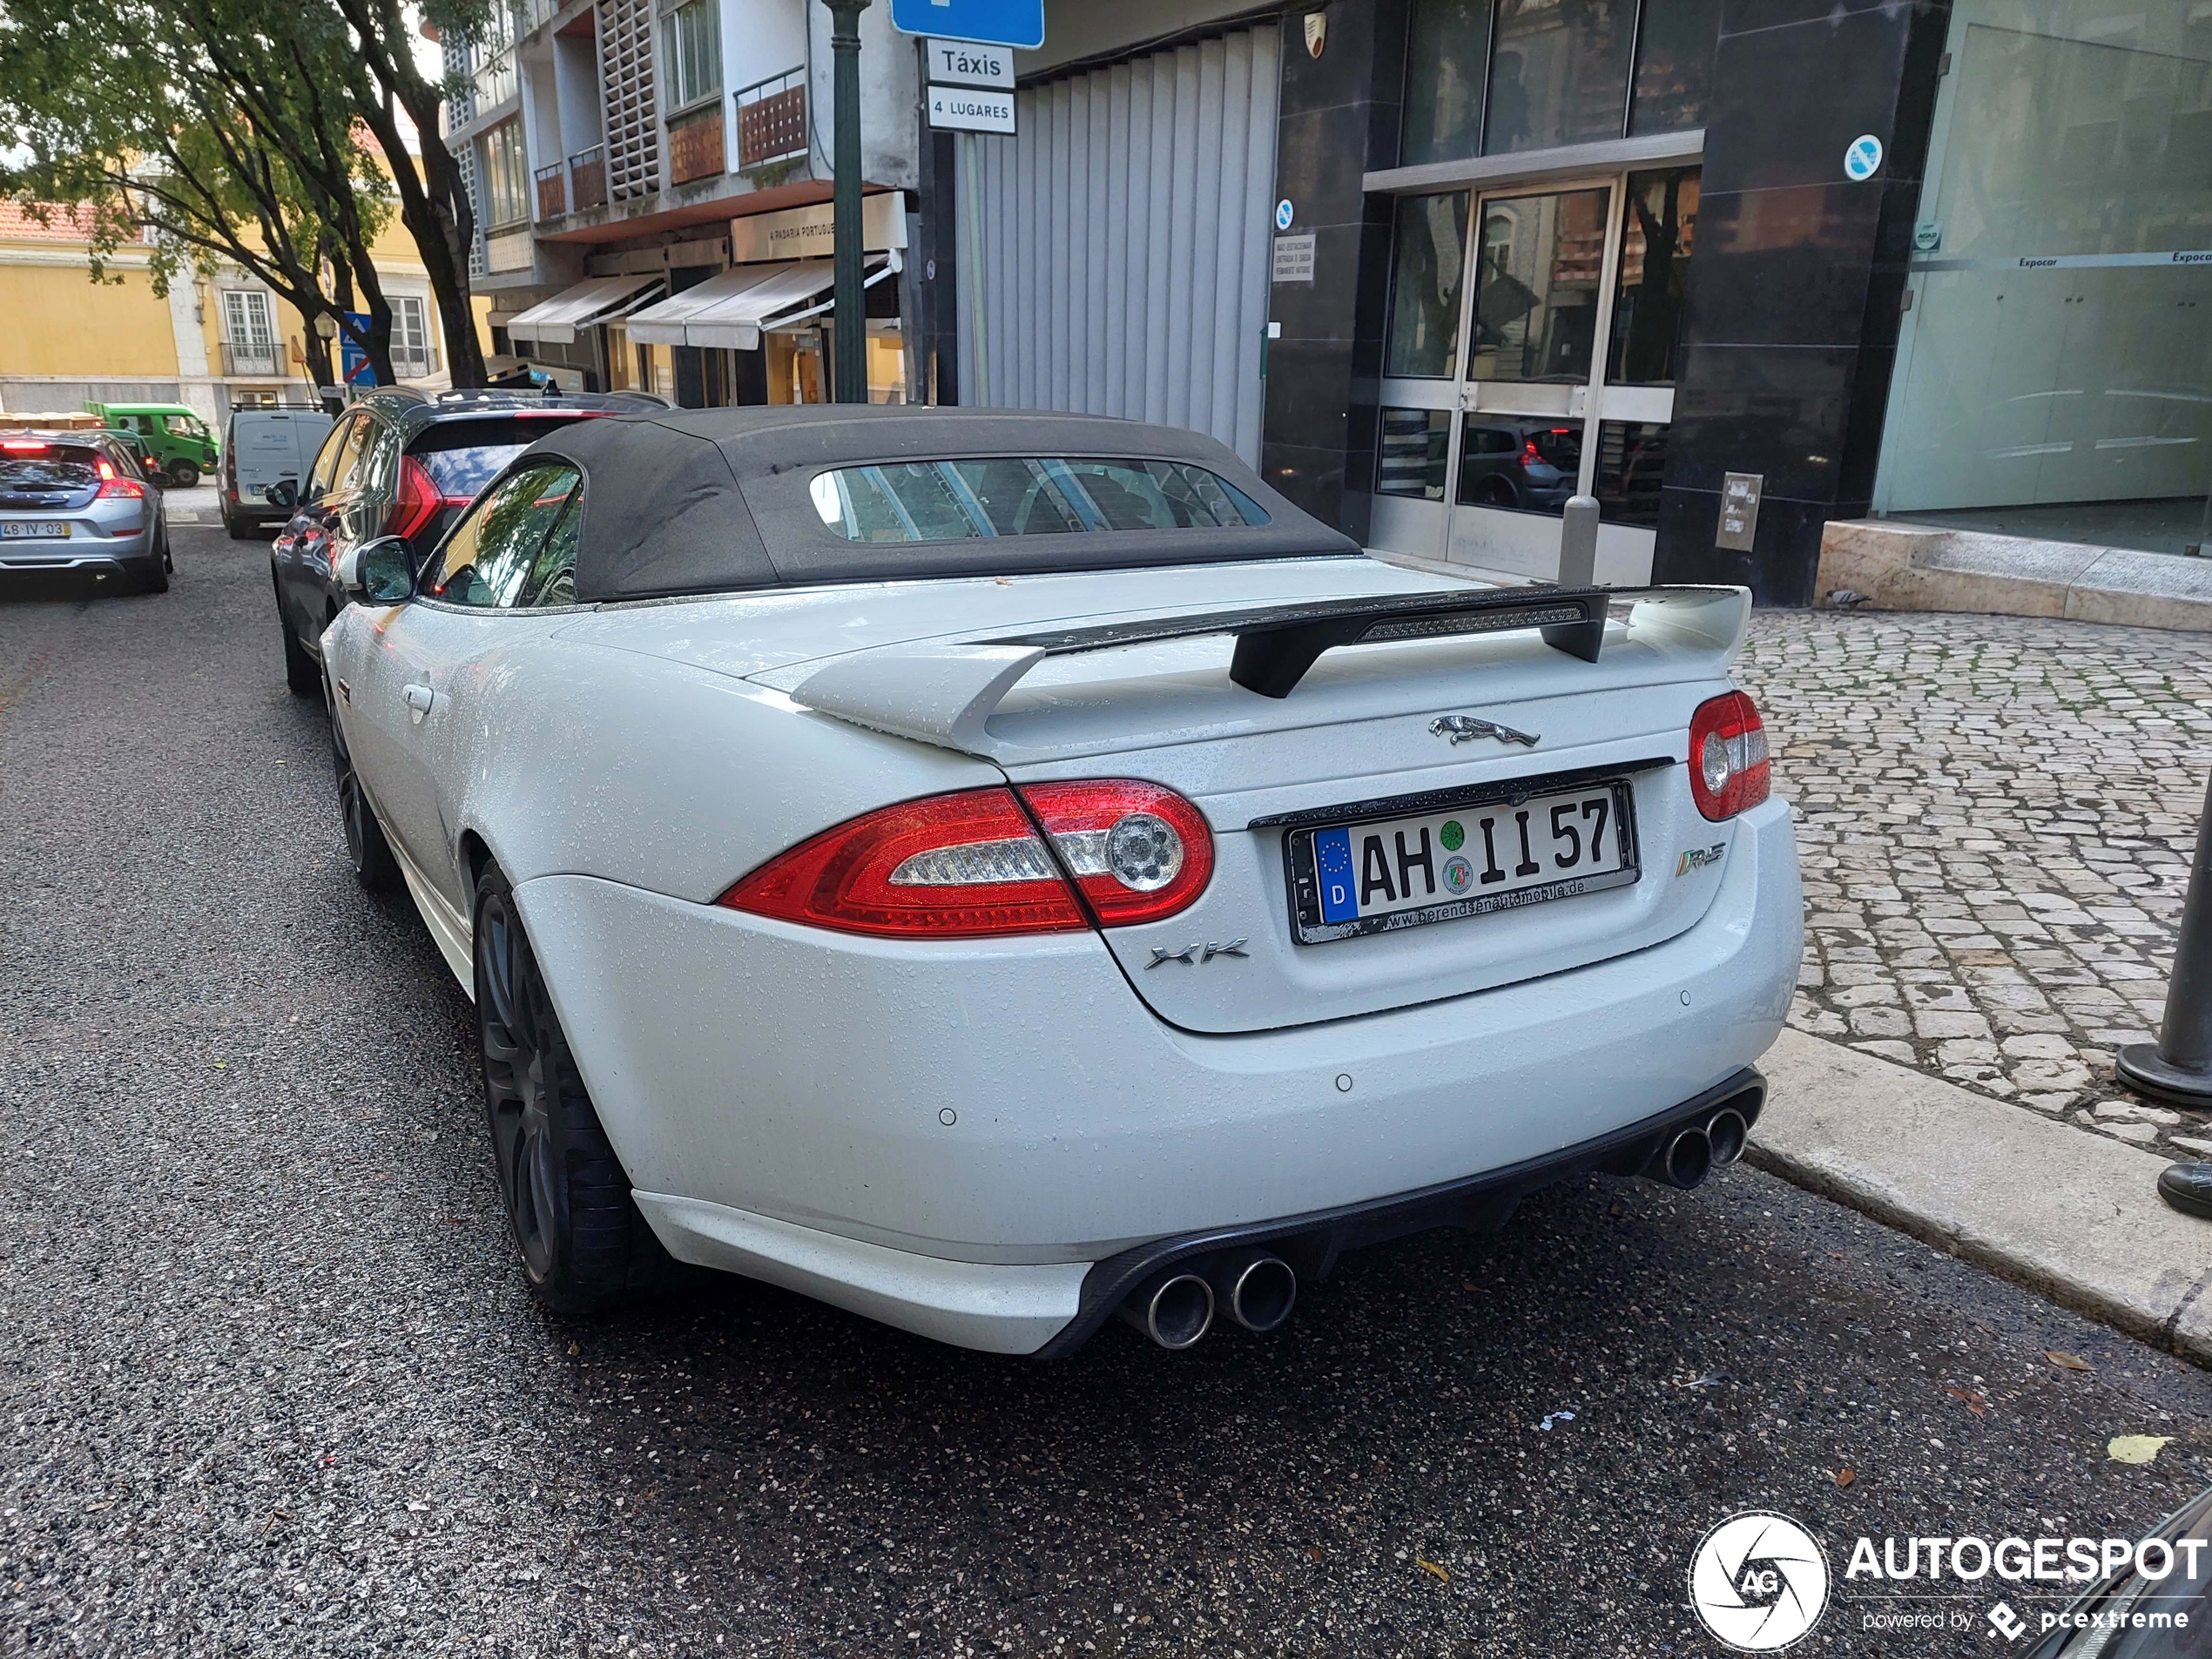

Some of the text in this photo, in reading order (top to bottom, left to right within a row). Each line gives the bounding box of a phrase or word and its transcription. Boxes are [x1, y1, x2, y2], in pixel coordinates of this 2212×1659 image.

[941, 50, 1001, 76] Táxis
[934, 101, 1009, 119] 4 LUGARES
[770, 231, 774, 240] A
[775, 228, 800, 239] PADARIA
[2020, 258, 2057, 269] Expocar
[1360, 826, 1435, 907] AH
[1550, 798, 1609, 869] 57
[1332, 884, 1345, 906] D
[1143, 937, 1251, 970] XK
